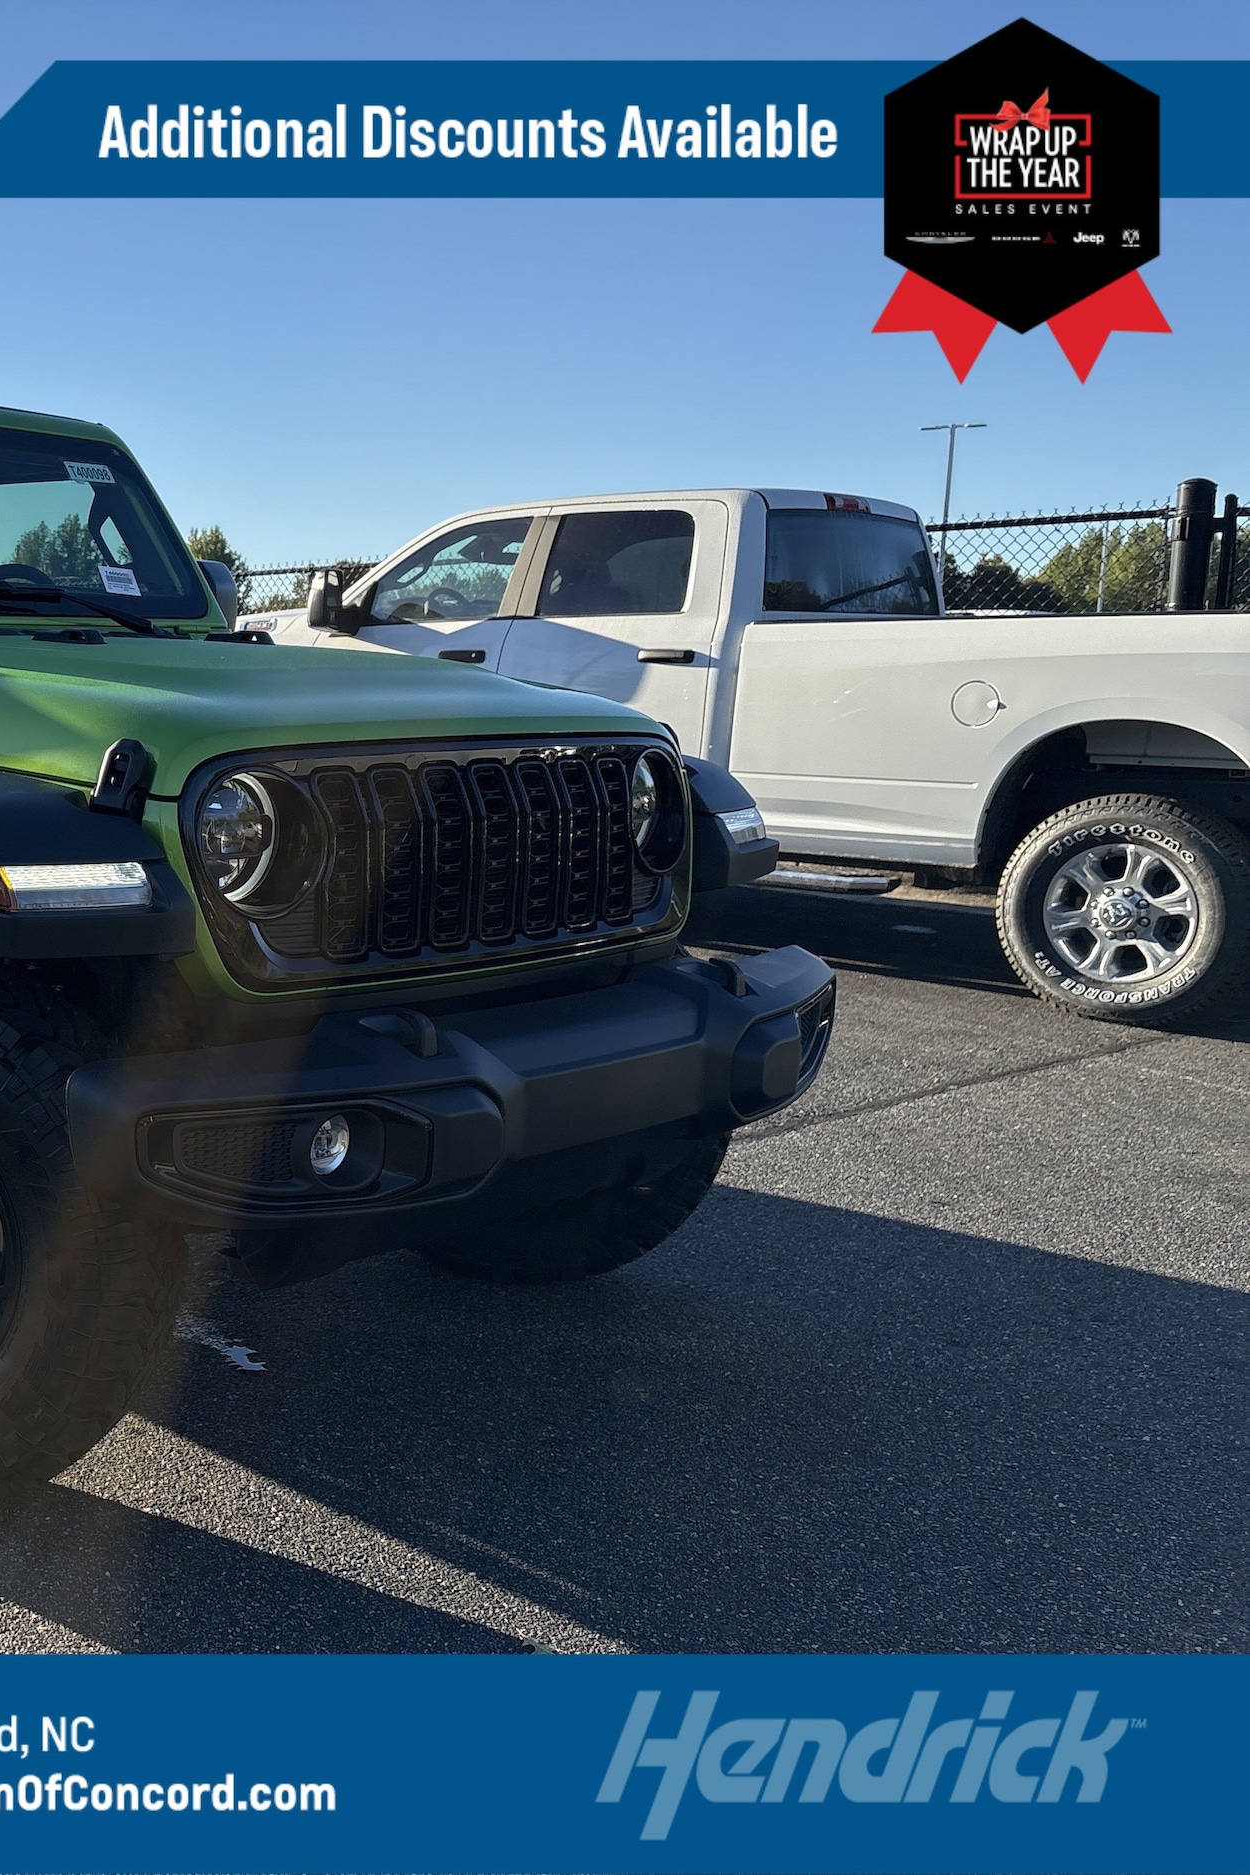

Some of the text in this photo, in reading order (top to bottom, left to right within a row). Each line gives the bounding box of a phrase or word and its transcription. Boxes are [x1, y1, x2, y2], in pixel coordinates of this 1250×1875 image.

[68, 465, 111, 481] T400098
[1047, 822, 1196, 864] Firestone
[1060, 967, 1196, 1005] TRANSFORCE
